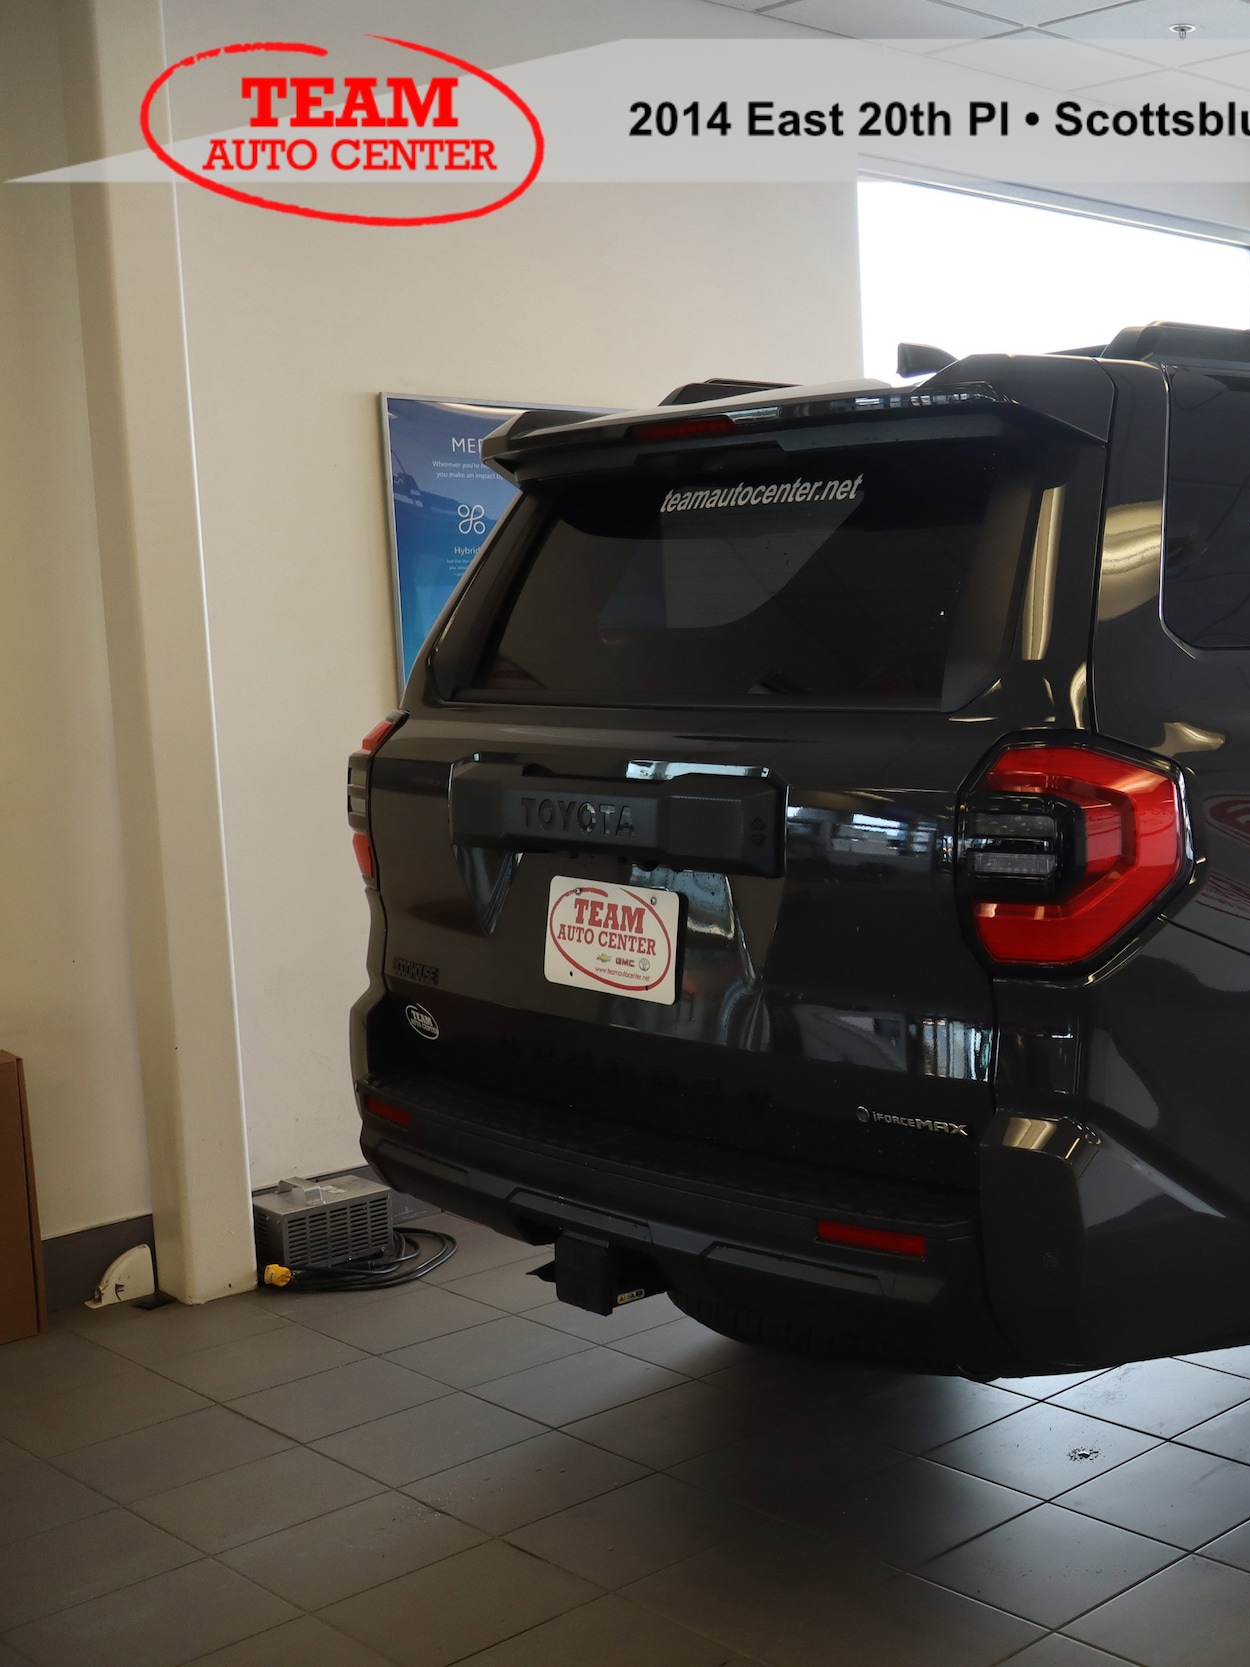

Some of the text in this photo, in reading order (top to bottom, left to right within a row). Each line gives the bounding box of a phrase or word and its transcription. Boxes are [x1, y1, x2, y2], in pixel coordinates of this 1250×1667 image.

[431, 460, 461, 468] Wherever
[475, 472, 496, 480] impact
[660, 473, 864, 513] teamautocenter.net
[521, 797, 636, 837] TOYOTA
[574, 897, 646, 935] TEAM
[557, 923, 657, 956] AUTO CENTER
[615, 956, 635, 968] GMC
